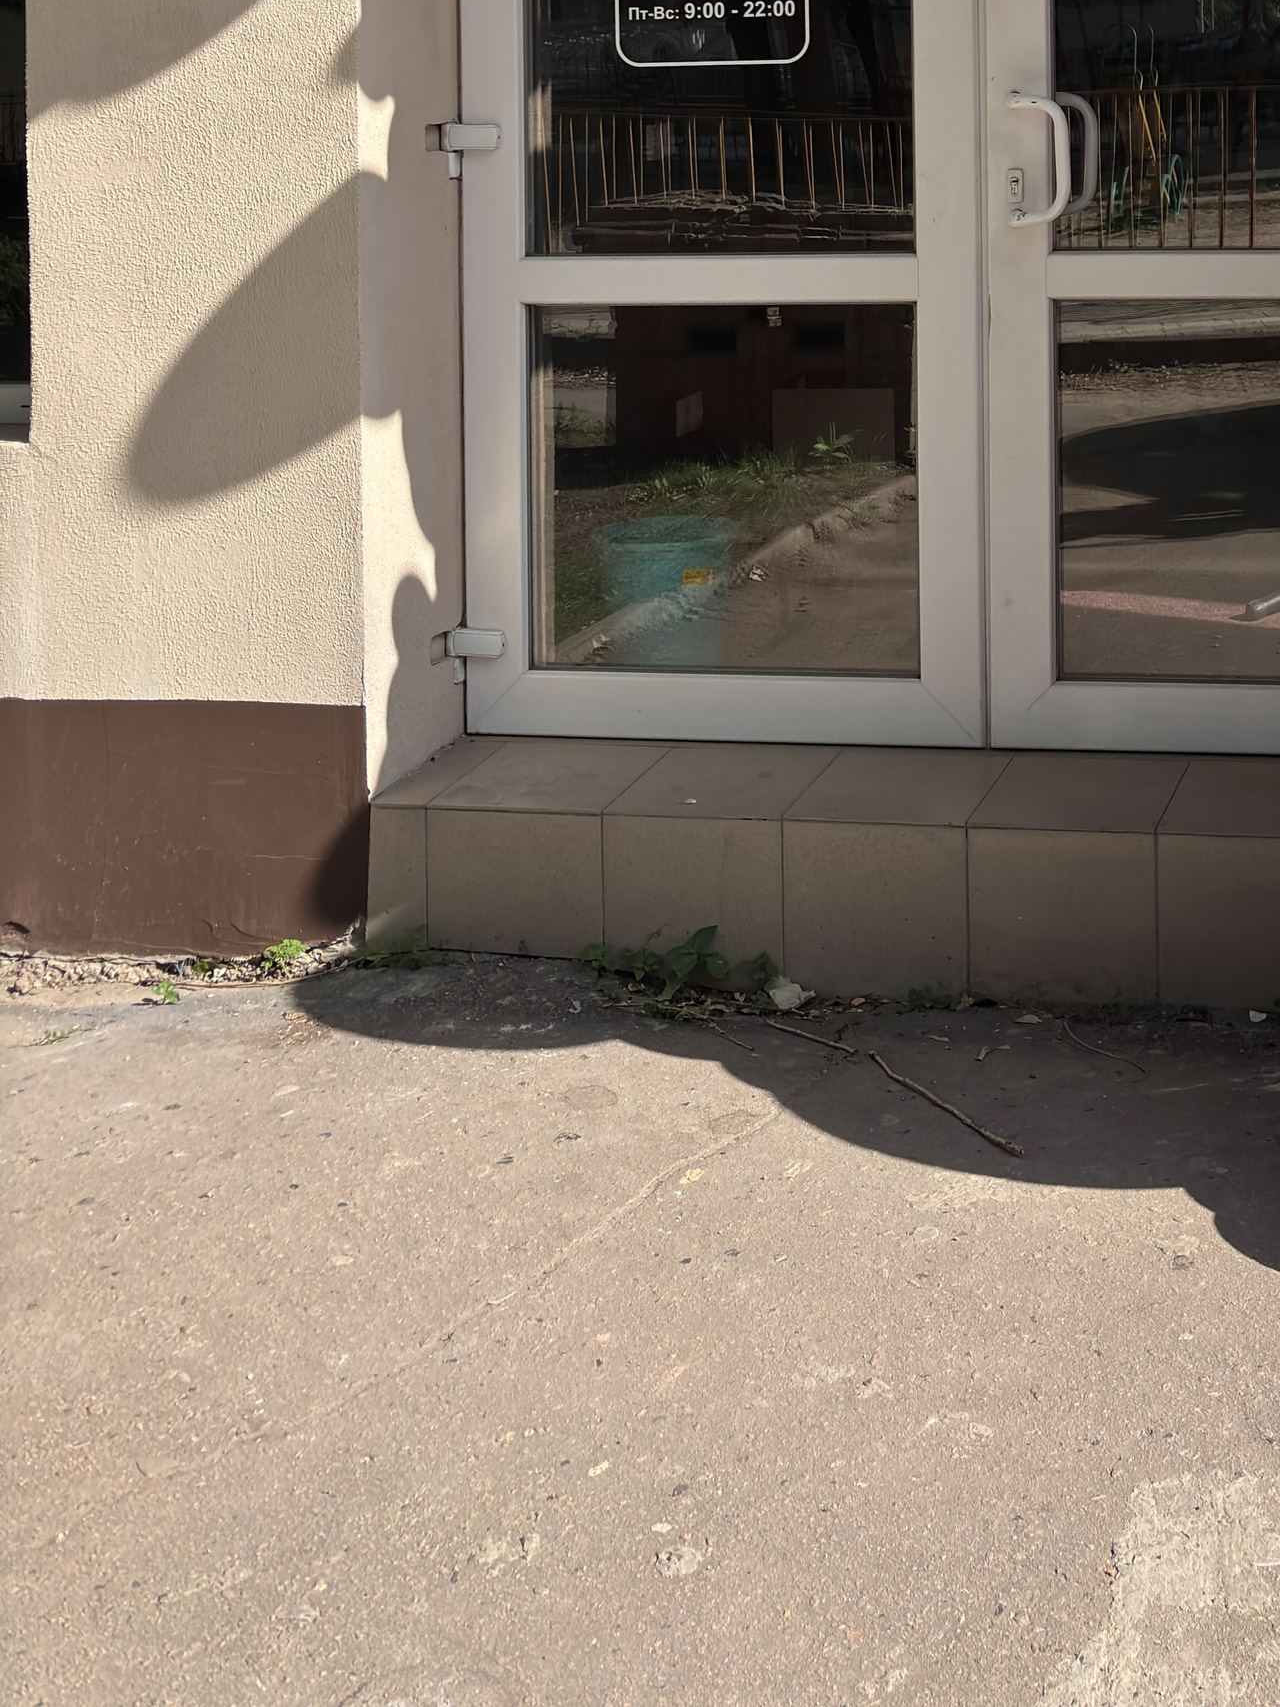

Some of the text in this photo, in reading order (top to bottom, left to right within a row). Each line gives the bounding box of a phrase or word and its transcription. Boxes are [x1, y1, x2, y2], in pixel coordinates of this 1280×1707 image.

[628, 6, 680, 21] Пт-Вс:
[684, 2, 725, 19] 9:00
[743, 0, 796, 18] 22:00
